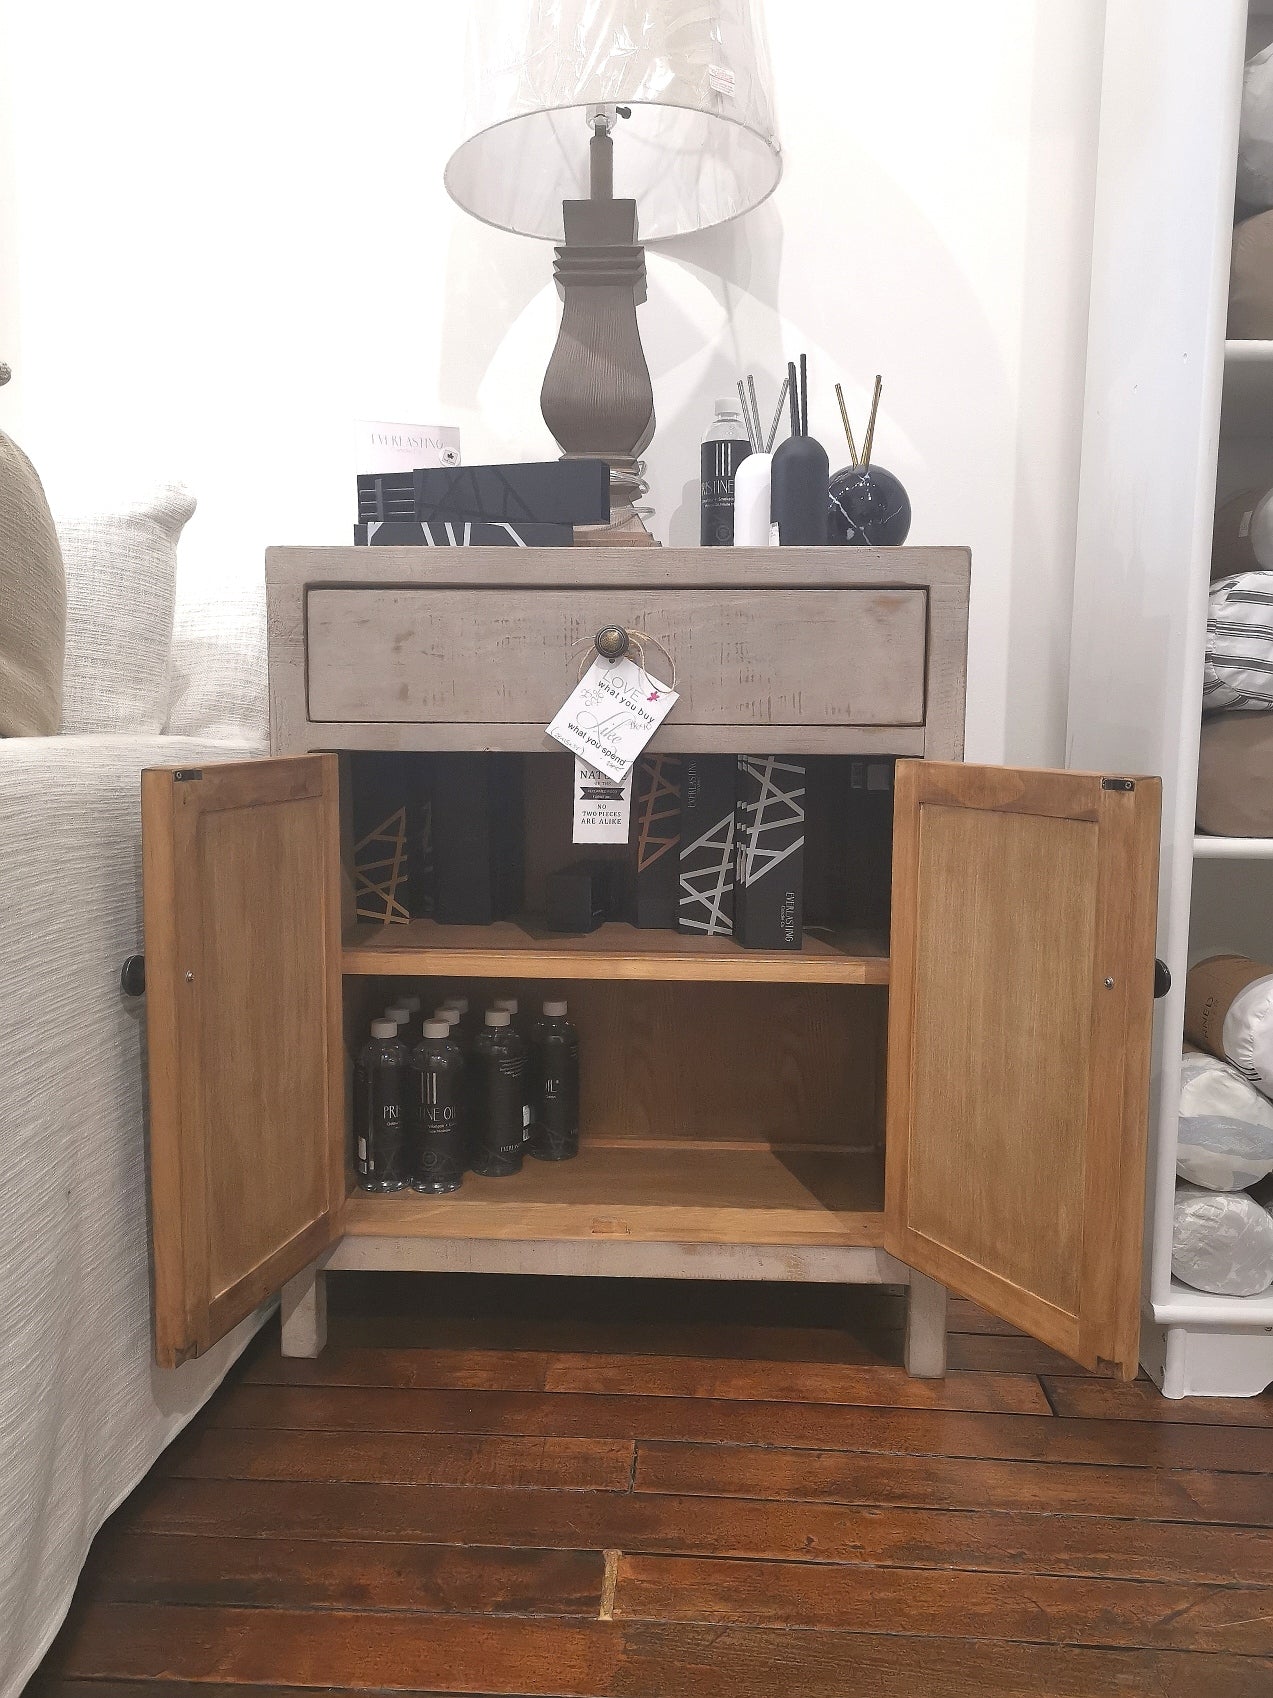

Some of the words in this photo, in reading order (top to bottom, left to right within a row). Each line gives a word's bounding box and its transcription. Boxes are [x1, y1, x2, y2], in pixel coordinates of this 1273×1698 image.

[598, 681, 620, 701] what
[620, 696, 638, 713] you
[637, 707, 656, 724] buy
[602, 669, 640, 703] LOVE
[567, 721, 588, 742] what
[586, 734, 602, 753] you
[601, 745, 628, 767] spend
[576, 710, 638, 747] Like
[784, 892, 795, 943] EVERLASTING
